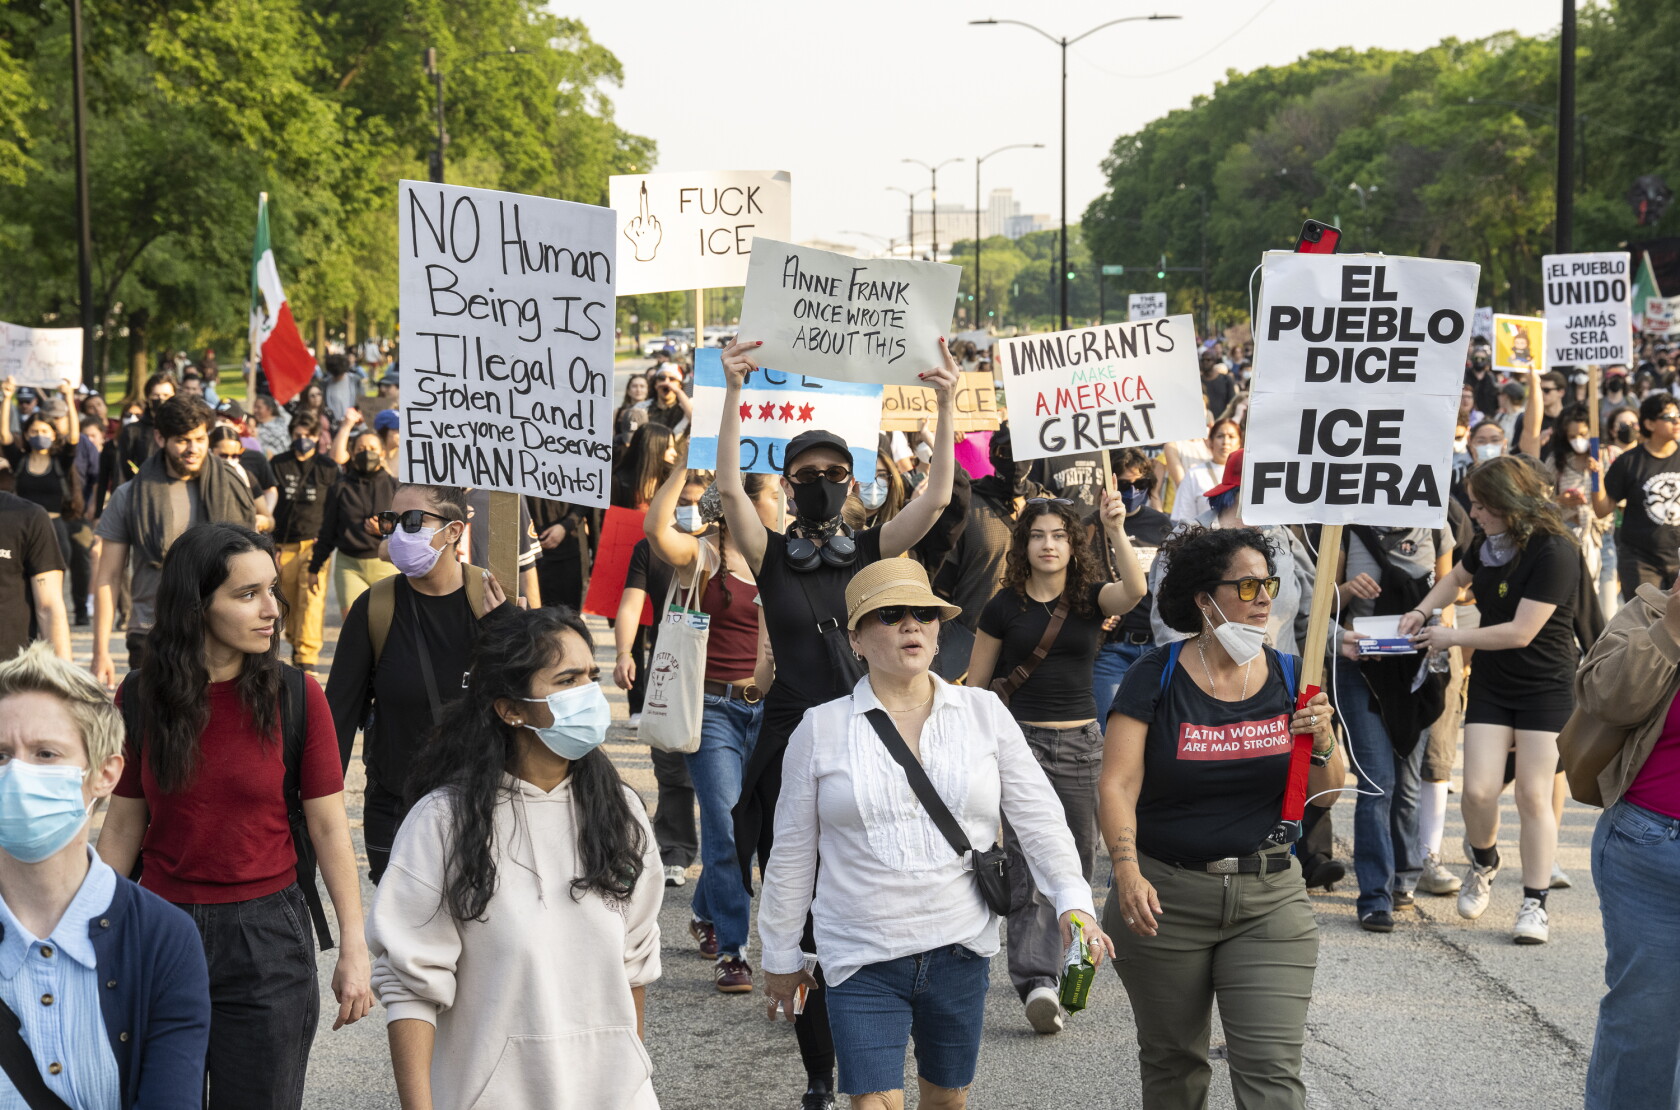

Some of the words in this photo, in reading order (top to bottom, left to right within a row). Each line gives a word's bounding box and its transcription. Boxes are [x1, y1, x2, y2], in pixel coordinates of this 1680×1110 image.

[680, 186, 763, 216] FUCK
[408, 188, 480, 263] NO
[499, 200, 610, 284] Human
[700, 224, 755, 256] ICE
[783, 254, 843, 297] ANNE
[848, 267, 910, 306] FRANK
[1341, 265, 1398, 302] EL
[1548, 264, 1568, 280] ¡EL
[1572, 260, 1625, 276] PUEBLO
[425, 264, 541, 342] Being
[552, 296, 606, 341] IS
[1548, 280, 1626, 305] UNIDO
[794, 298, 843, 323] ONCE
[847, 307, 906, 329] WROTE
[1268, 306, 1464, 344] PUEBLO
[1565, 311, 1616, 329] JAMÁS
[792, 325, 860, 356] ABOUT
[863, 331, 906, 365] THIS
[1009, 318, 1175, 376] IMMIGRANTS
[1556, 345, 1624, 361] VENCIDO!
[1570, 326, 1609, 345] SERÁ
[414, 332, 555, 395] Illegal
[568, 356, 606, 397] On
[1071, 365, 1117, 385] MAKE
[1305, 347, 1419, 384] DICE
[411, 377, 501, 415] Stolen
[508, 388, 595, 435] Land!
[881, 386, 938, 414] olish
[954, 388, 995, 413] CE
[1035, 375, 1154, 416] AMERICA
[406, 407, 516, 447] Everyone
[520, 420, 612, 462] Deserves
[1039, 402, 1156, 452] GREAT
[1297, 408, 1405, 457] ICE
[406, 440, 514, 487] HUMAN
[518, 450, 604, 499] Rights!
[1251, 461, 1442, 507] FUERA
[1182, 742, 1207, 752] ARE
[1211, 742, 1240, 752] MAD
[1244, 735, 1289, 750] STRONG.
[1185, 728, 1225, 740] LATIN
[1230, 719, 1286, 739] WOMEN
